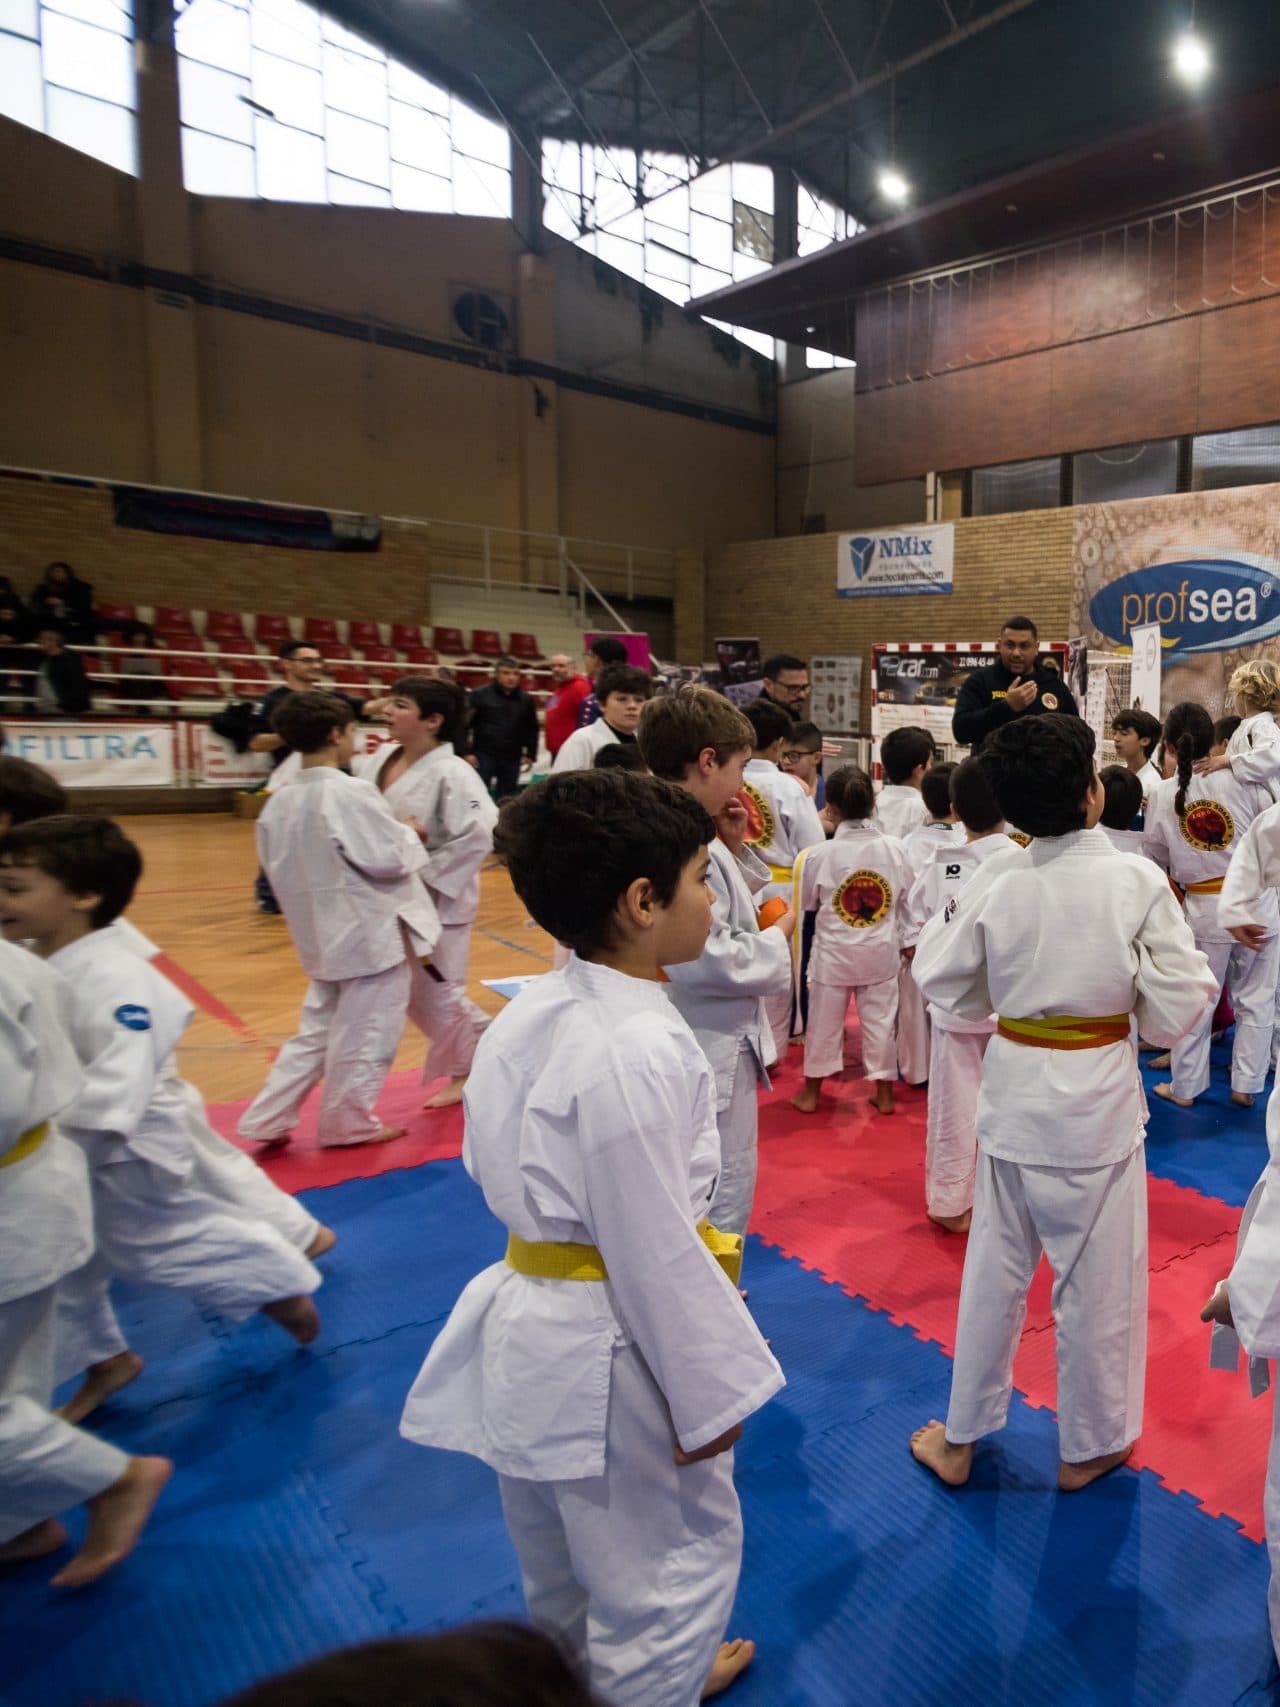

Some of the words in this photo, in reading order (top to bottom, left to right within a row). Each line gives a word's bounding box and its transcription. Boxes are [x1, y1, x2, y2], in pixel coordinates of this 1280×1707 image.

[879, 536, 932, 559] NMix
[1122, 580, 1257, 636] profsea
[2, 734, 158, 761] FILTRA
